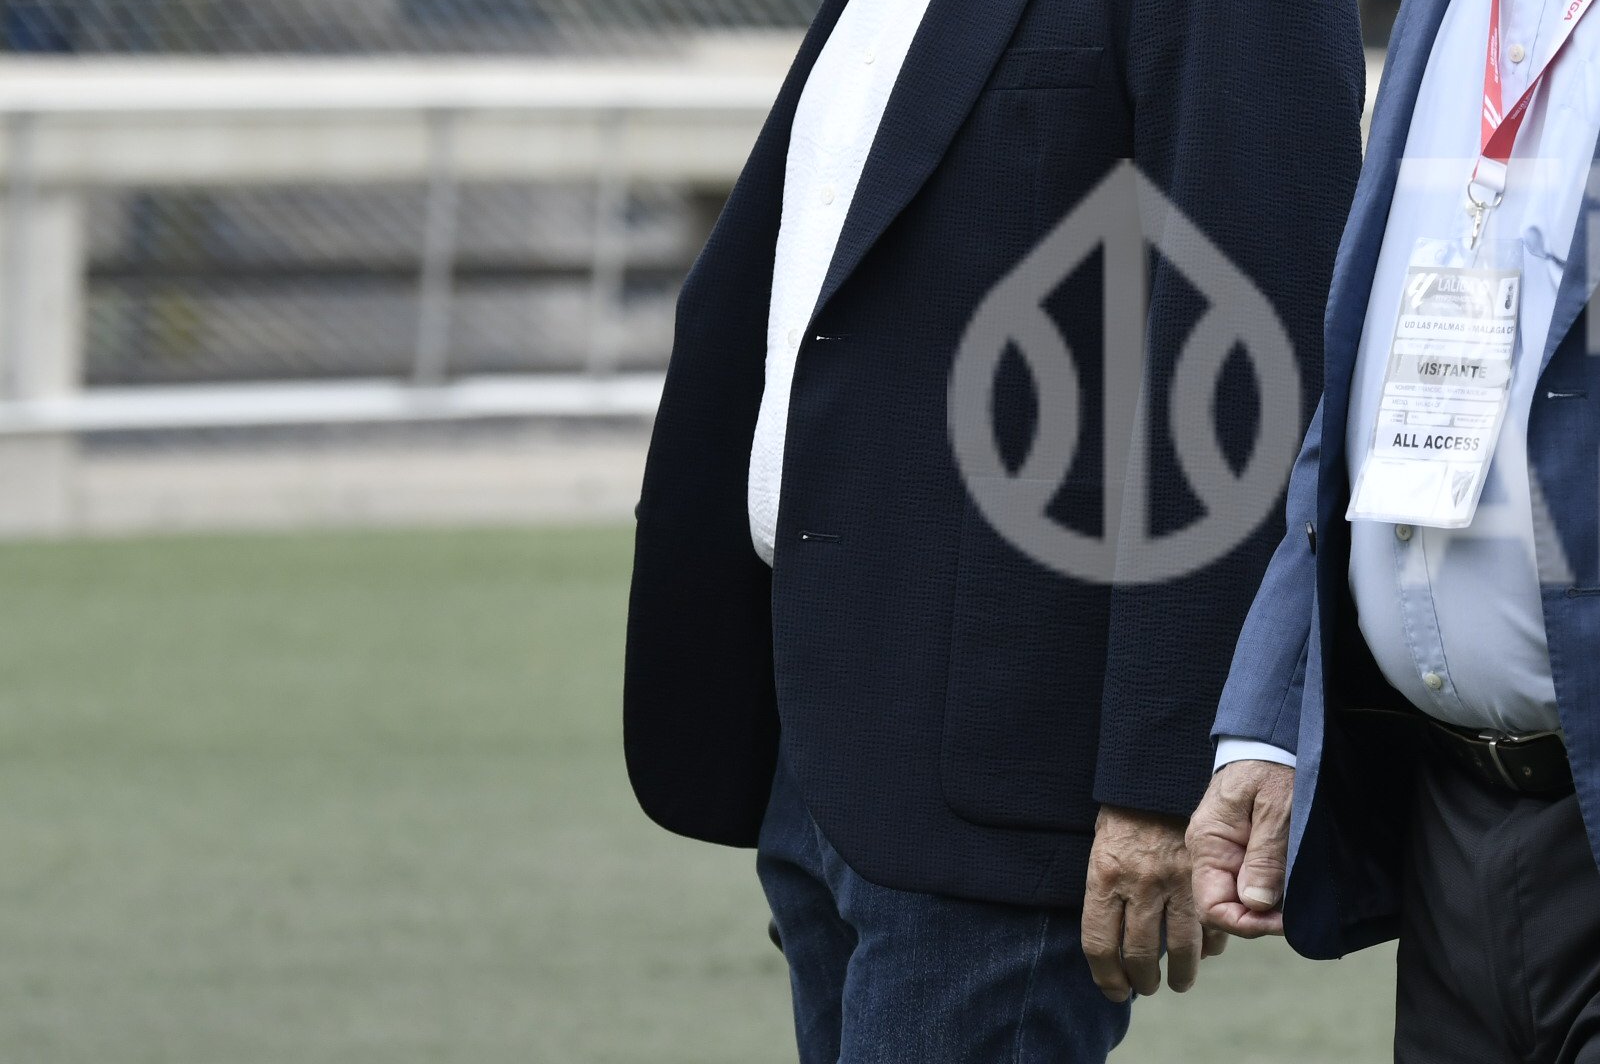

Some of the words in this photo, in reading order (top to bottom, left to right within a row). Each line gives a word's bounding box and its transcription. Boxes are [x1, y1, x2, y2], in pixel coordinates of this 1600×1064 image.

[1404, 320, 1416, 329] UD
[1416, 321, 1432, 330] LAS
[1433, 322, 1465, 332] PALMAS
[1417, 361, 1488, 379] VISITANTE
[1392, 432, 1419, 448] ALL
[1423, 434, 1480, 451] ACCESS
